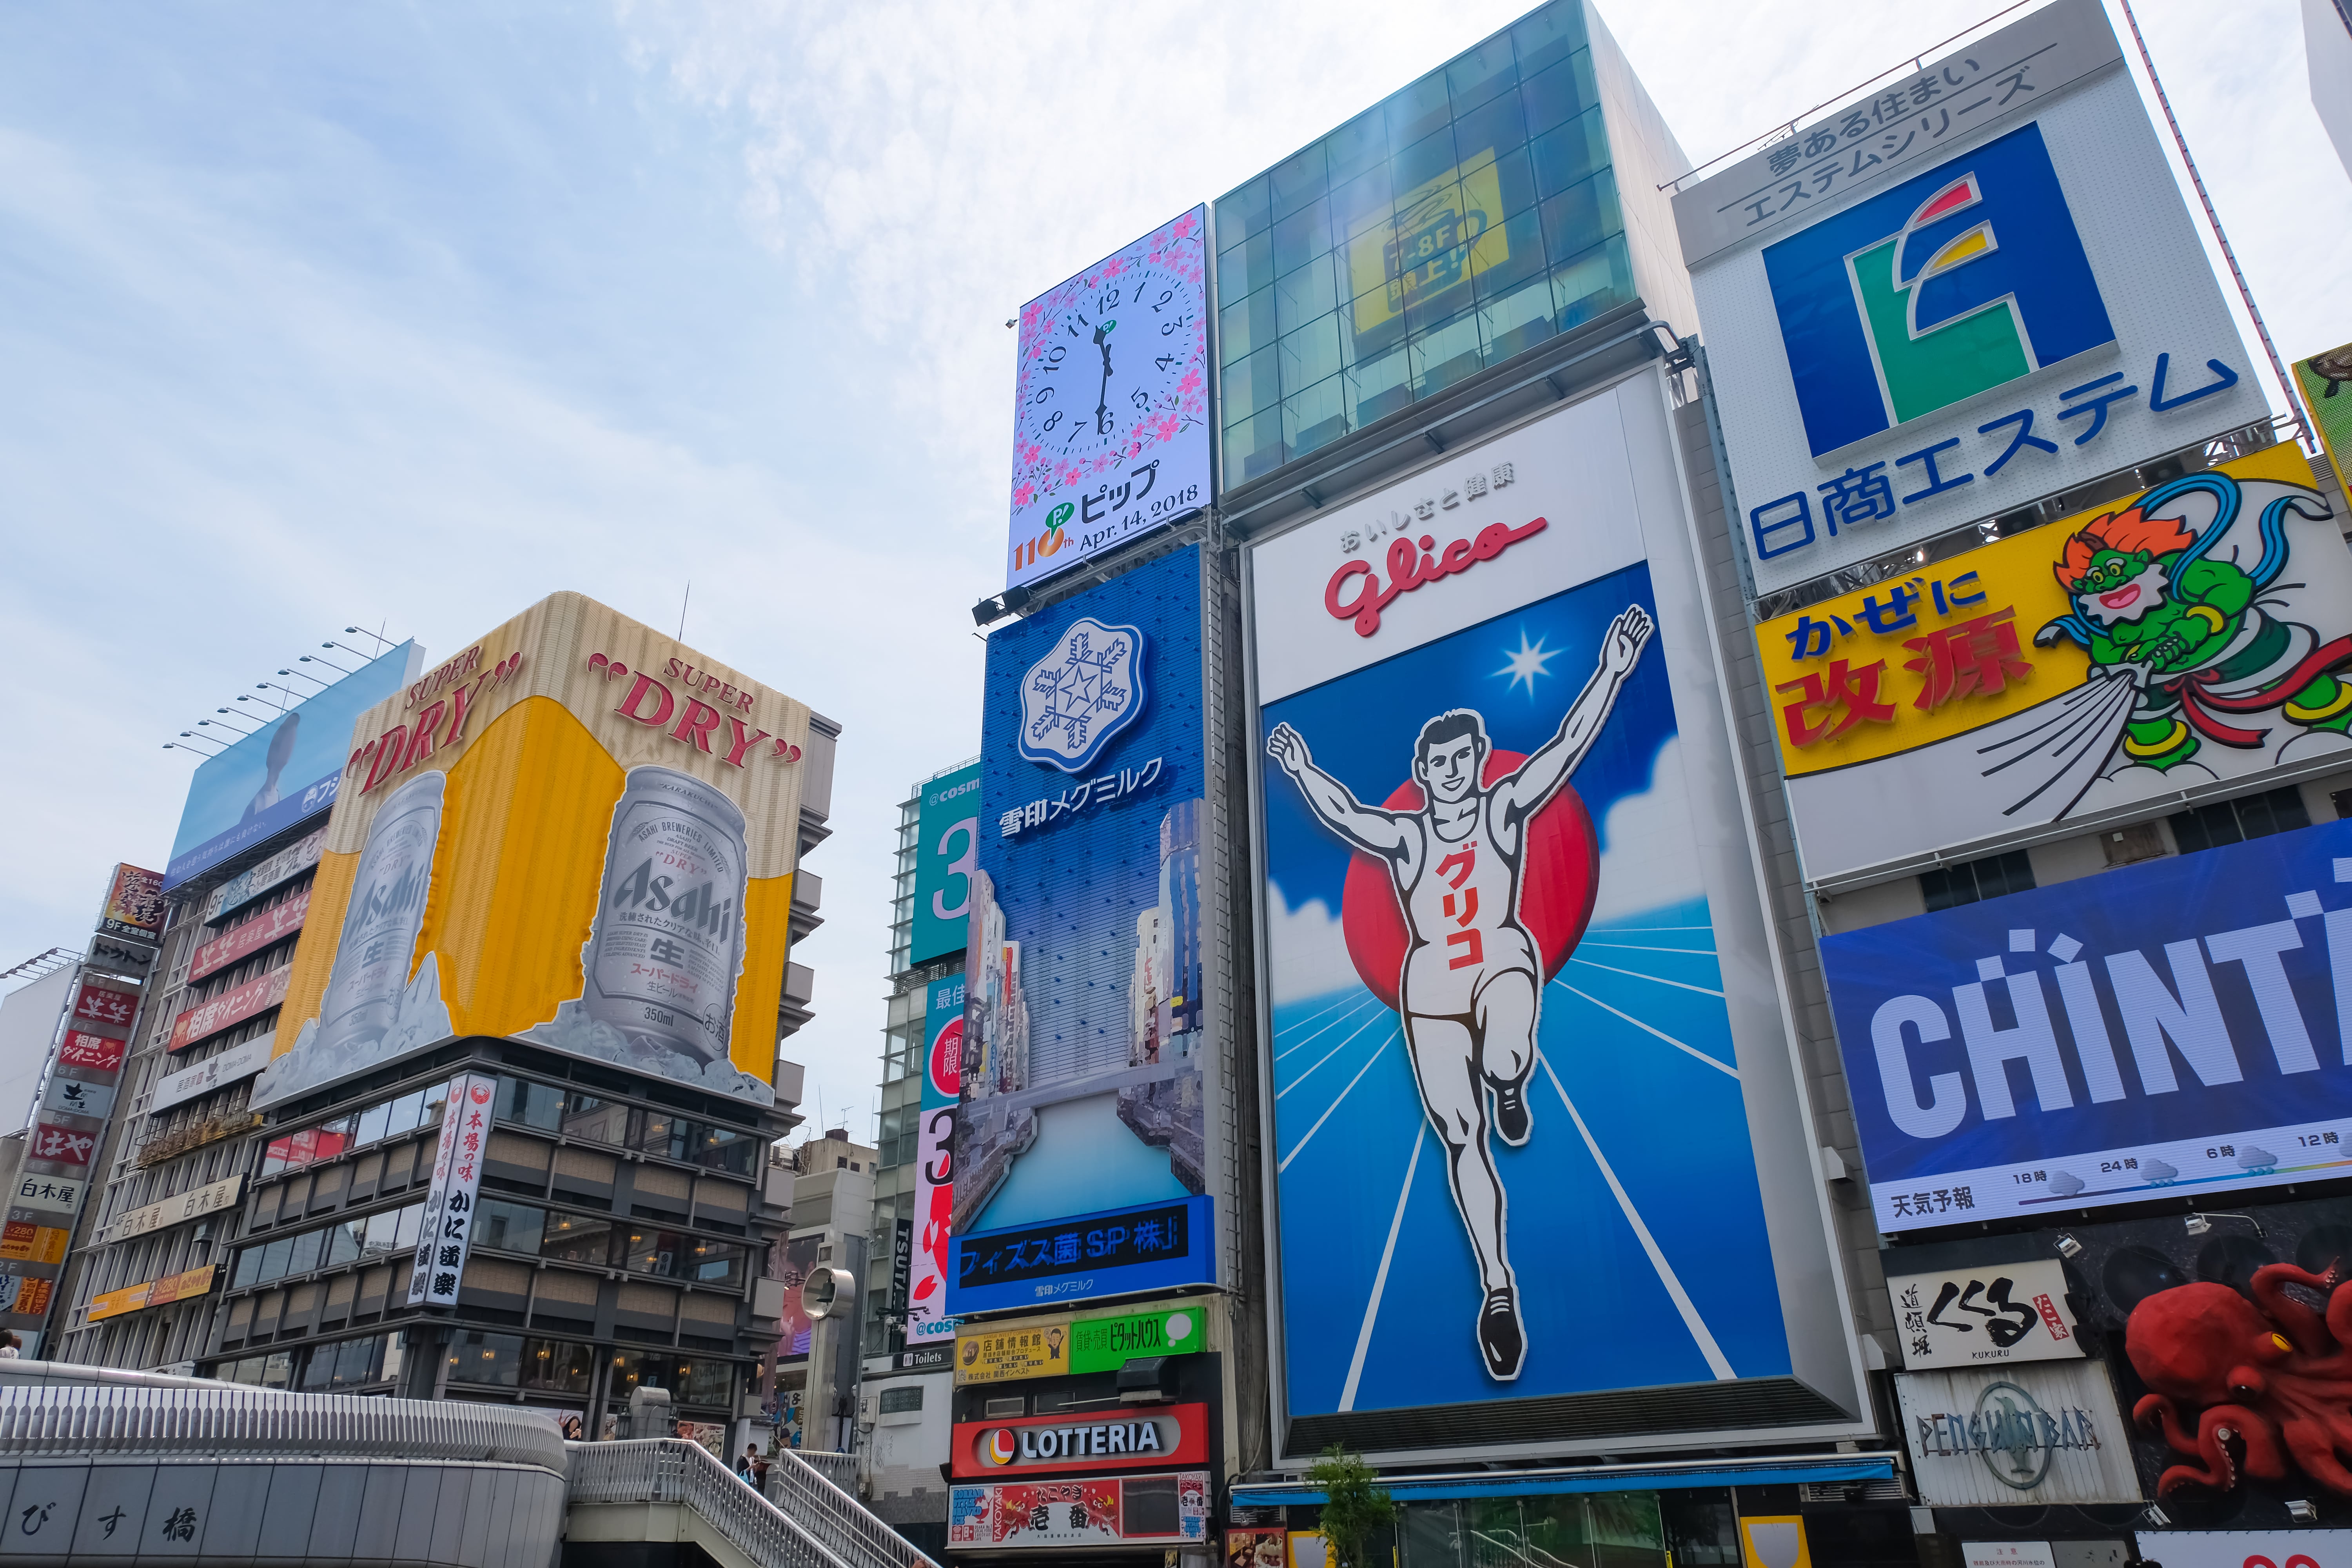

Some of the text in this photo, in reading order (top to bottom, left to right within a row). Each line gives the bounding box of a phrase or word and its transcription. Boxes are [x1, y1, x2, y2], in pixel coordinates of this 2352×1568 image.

[1766, 58, 1980, 177] 夢ある住まい
[1744, 65, 2035, 227] エステムシリーズ
[1389, 224, 1450, 271] 7-8F
[1096, 289, 1120, 315] 12
[1133, 281, 1146, 303] 1
[1151, 290, 1173, 313] 2
[1067, 313, 1089, 338] 11
[1161, 315, 1182, 336] 3
[1043, 346, 1067, 375] 10
[1154, 353, 1174, 372] 4
[1035, 387, 1055, 404] 9
[1131, 386, 1149, 408] 5
[1043, 410, 1063, 432] 8
[1068, 421, 1088, 443] 7
[1101, 412, 1114, 434] 6
[1749, 351, 2239, 561] 日商エステム
[1081, 459, 1160, 524] ピップ
[1079, 484, 1199, 552] Apr. 14, 2018
[1340, 461, 1515, 553] おいしさと健康
[1785, 570, 1987, 663] かぜに
[404, 645, 482, 711] SUPER
[663, 657, 754, 714] SUPER
[1775, 604, 2035, 748] 改源
[999, 756, 1163, 838] 雪印メグミルク
[638, 822, 724, 873] ASAHI BREWERIES LIMITED
[667, 837, 684, 847] DRAFT
[675, 834, 692, 843] ASAHI
[670, 849, 692, 861] SUPER
[208, 894, 224, 916] 9F
[347, 861, 425, 942] Asahi
[613, 856, 732, 945] Asahi
[1435, 840, 1484, 971] グリコ
[107, 918, 121, 930] 9F
[361, 941, 385, 969] 生
[650, 938, 685, 970] 生
[630, 963, 698, 994] スーパードライ
[646, 981, 678, 998] 生ビール
[78, 995, 130, 1024] 笑笑
[186, 981, 267, 1040] 相席ダイニング
[644, 1007, 674, 1027] 350ml
[75, 1034, 102, 1049] 相席
[705, 1012, 726, 1045] お酒
[58, 1065, 78, 1076] 6F
[61, 1045, 121, 1068] ダイニング
[53, 1115, 71, 1124] 5F
[436, 1109, 456, 1181] 本場の味
[458, 1109, 483, 1183] 本場の味
[2013, 1131, 2339, 1184] 18時 24時 6時 12時
[20, 1178, 74, 1203] 白木屋
[1891, 1186, 1975, 1218] 天気予報
[11, 1210, 34, 1221] 3F
[122, 1185, 226, 1237] 白木屋 白木屋
[1035, 1279, 1093, 1297] 雪印メグミルク
[1900, 1283, 1933, 1358] 道頓堀
[1926, 1277, 2038, 1348] くくる
[983, 1334, 1041, 1352] 店舗情報館
[1111, 1318, 1161, 1352] ピタットハウス
[915, 1352, 942, 1365] Toilets
[1972, 1349, 2009, 1359] KUKURU
[968, 1368, 1030, 1381] 株式会社 関西インベスト
[1022, 1421, 1160, 1459] LOTTERIA
[2040, 1405, 2101, 1452] BAR
[1036, 1485, 1083, 1502] たこやき
[22, 1502, 197, 1543] びす橋
[994, 1488, 1003, 1541] TAKOYAKI
[1031, 1501, 1089, 1531] 壱番
